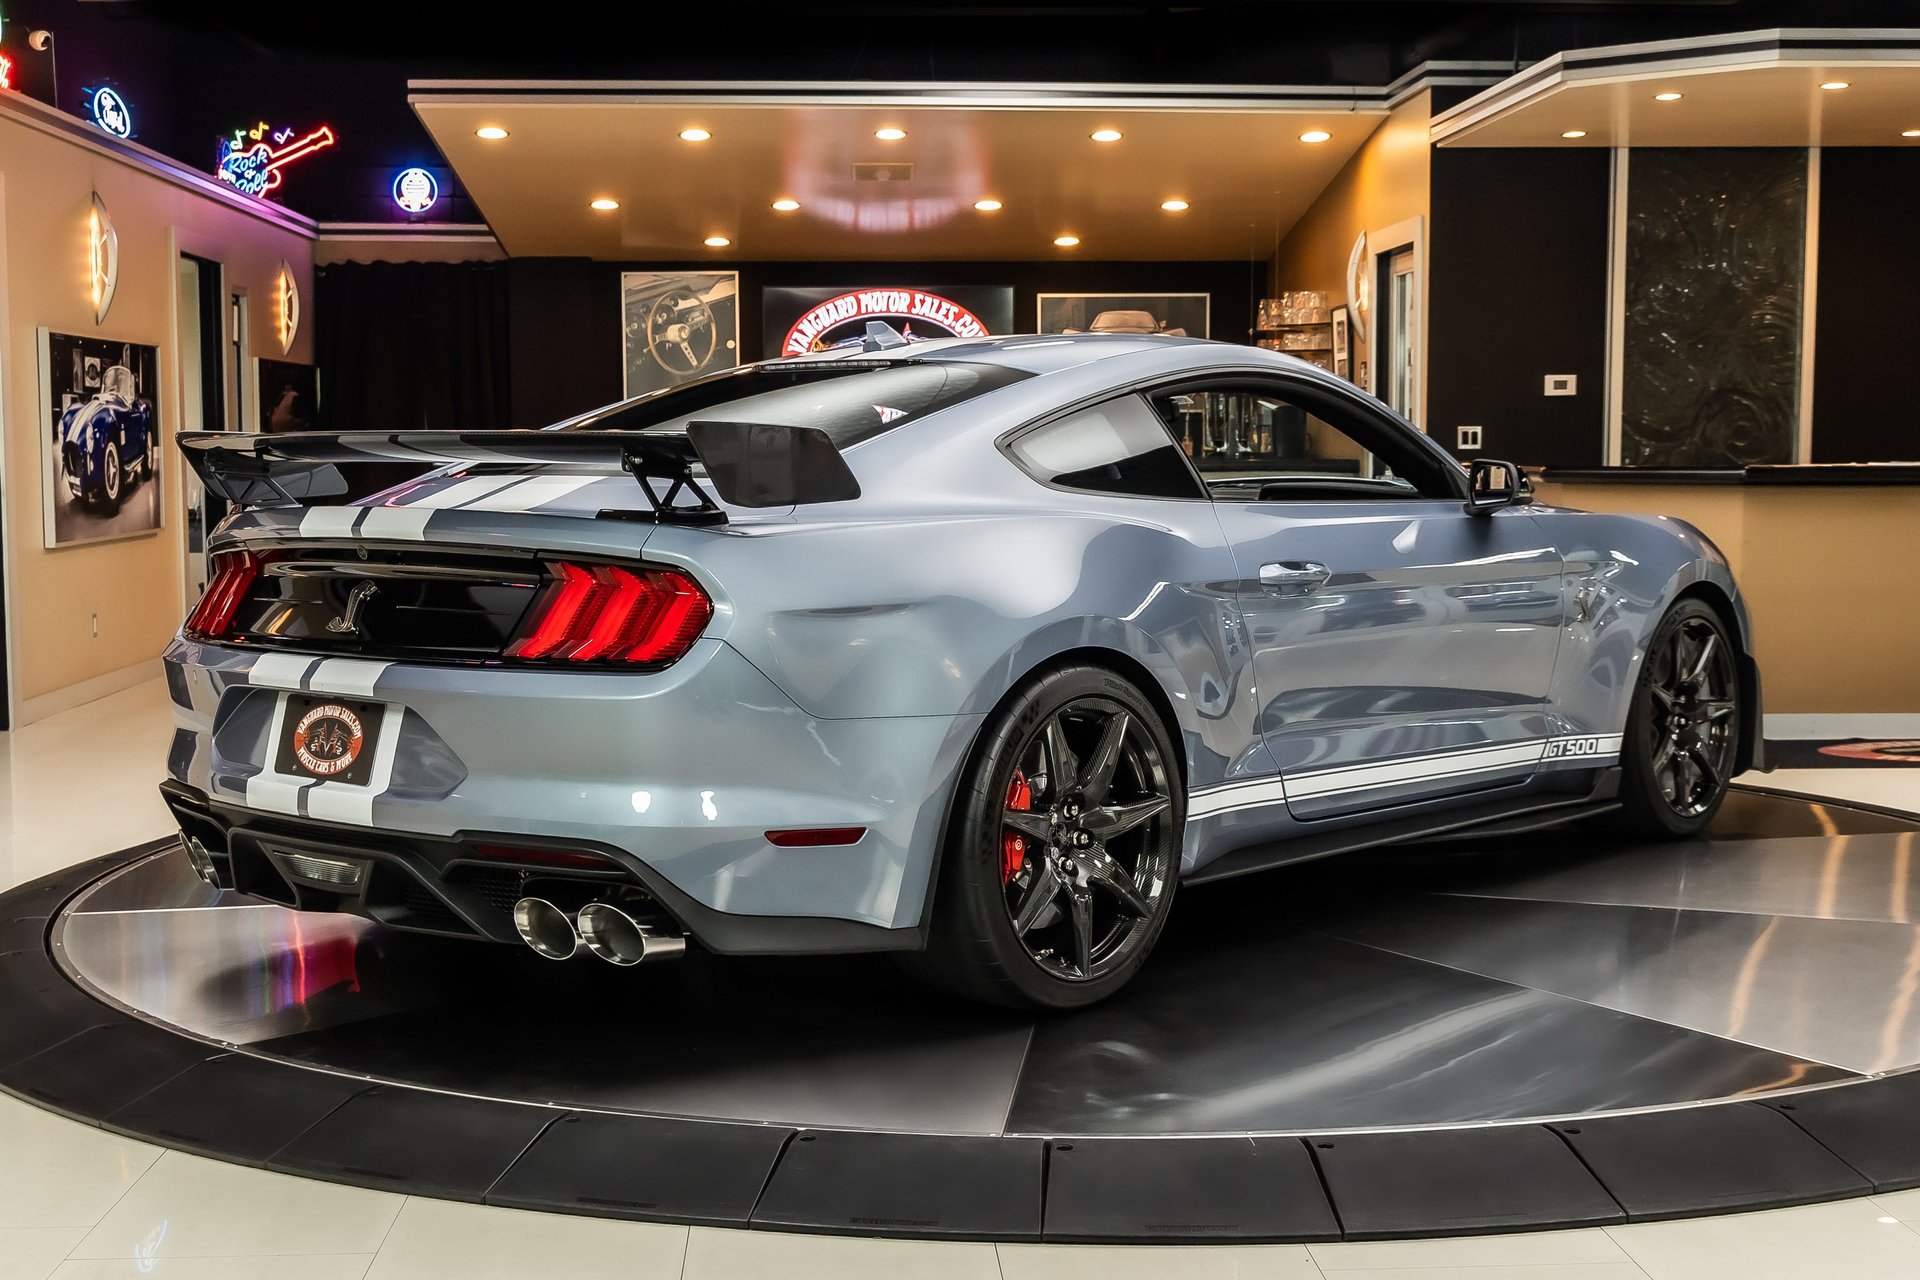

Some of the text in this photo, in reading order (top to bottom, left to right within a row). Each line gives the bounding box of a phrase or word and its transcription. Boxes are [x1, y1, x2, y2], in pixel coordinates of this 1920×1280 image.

[229, 147, 268, 173] Rock
[787, 291, 985, 353] VANGUARD MOTOR SALES.CO
[297, 705, 362, 739] VANGUARD MOTOR SALES.COM
[297, 746, 354, 774] MUSCLE CARS & MORE
[1549, 739, 1597, 757] GT500
